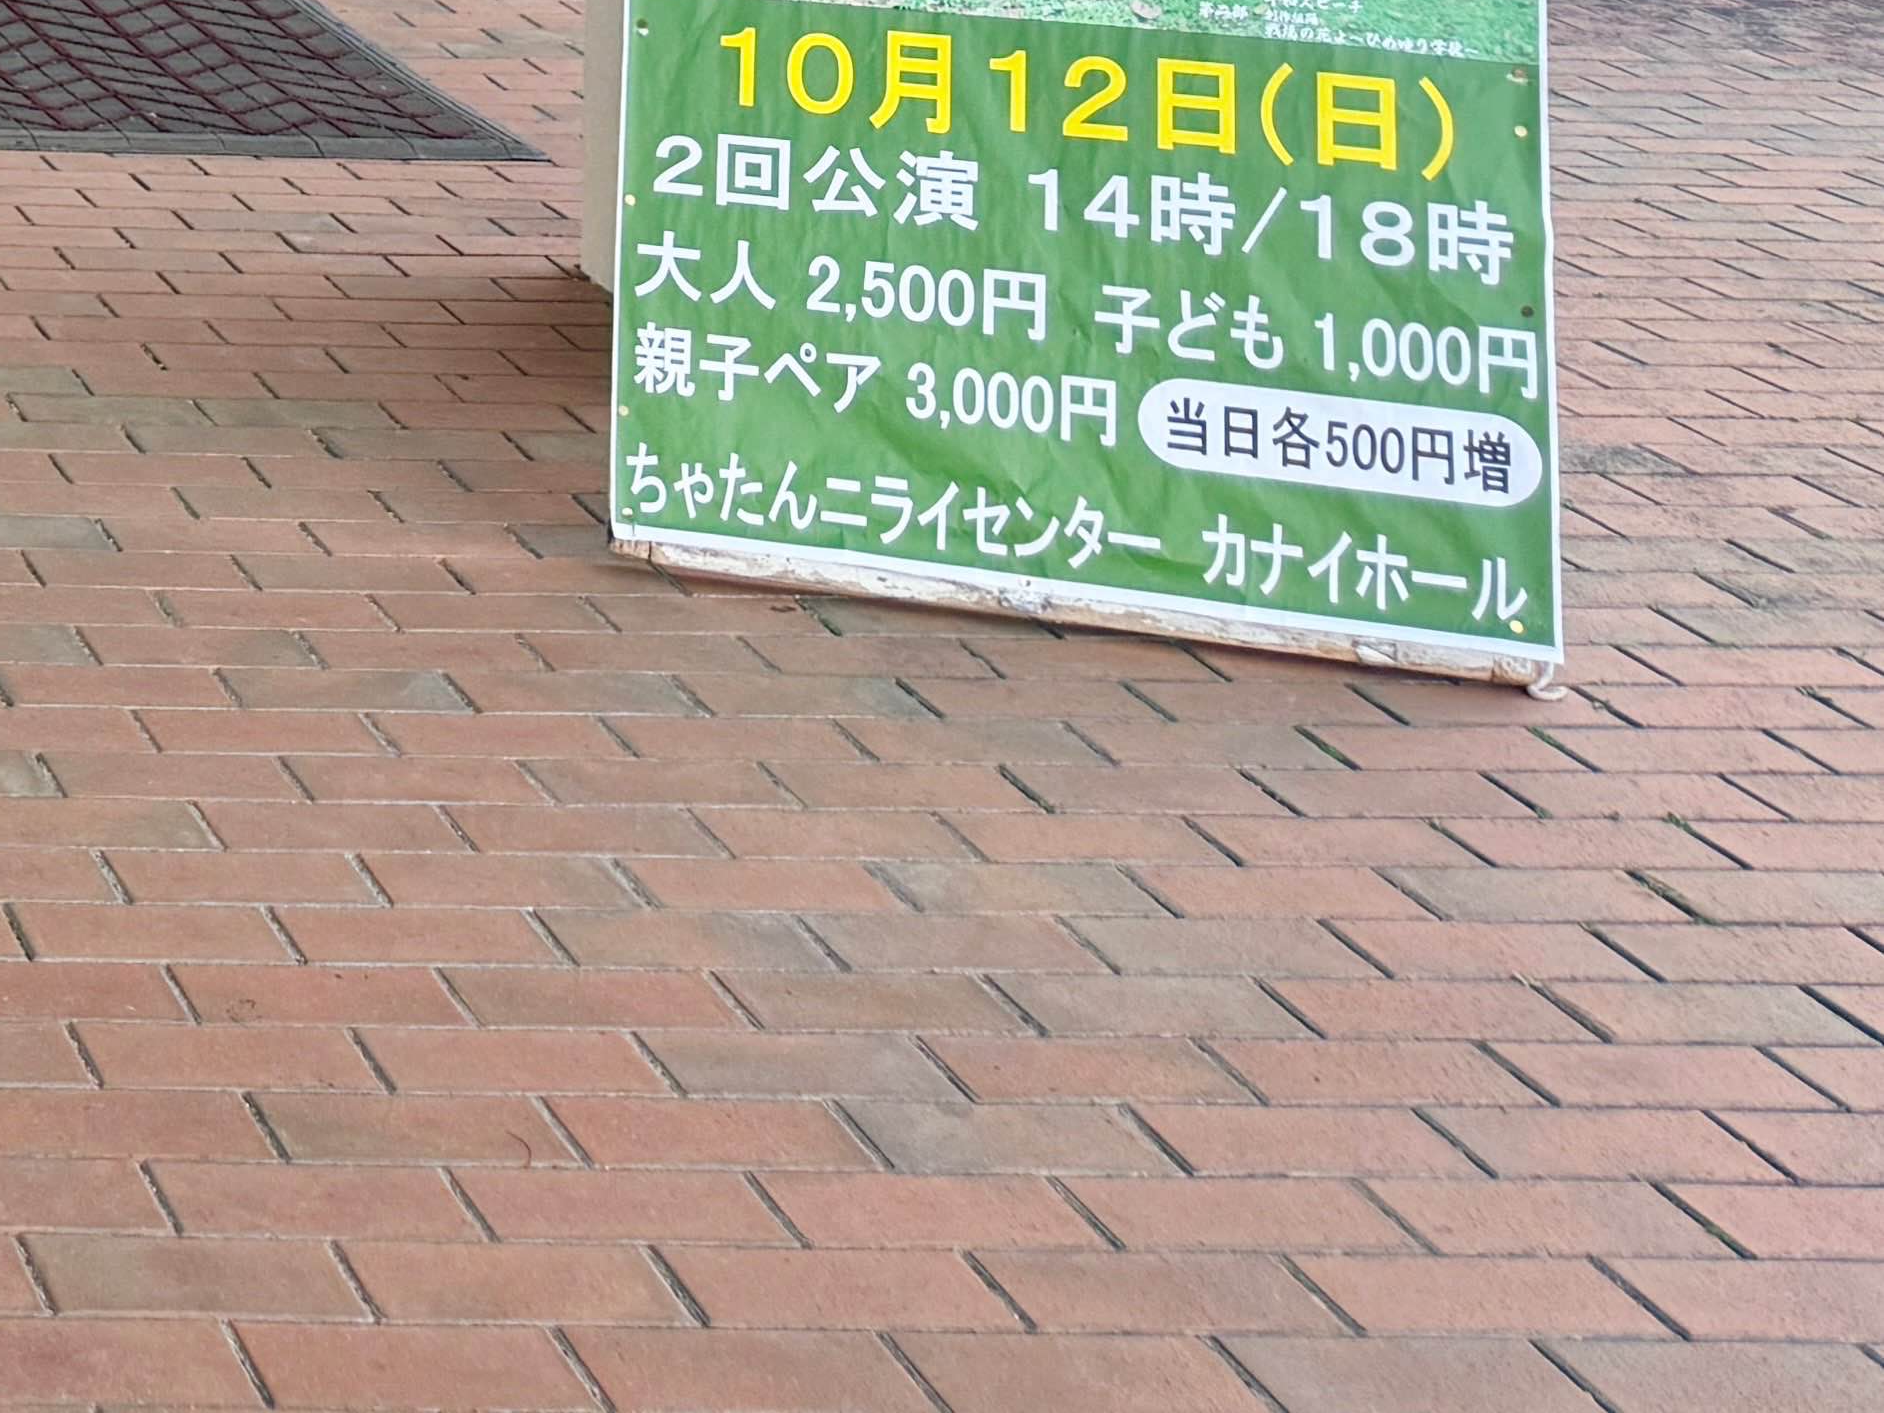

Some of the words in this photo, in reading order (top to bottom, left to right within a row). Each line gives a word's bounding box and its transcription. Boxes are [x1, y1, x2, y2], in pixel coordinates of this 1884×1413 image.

[719, 26, 1453, 180] 10月12日(日)
[654, 133, 980, 230] 2回公演
[1031, 172, 1514, 285] 14時/18時
[634, 234, 775, 311] 大人
[807, 254, 1047, 340] 2,500円
[1095, 286, 1284, 368] 子ども
[1315, 315, 1537, 399] 1,000円
[633, 324, 879, 415] 親子ペア
[905, 361, 1117, 446] 3,000円
[1166, 401, 1512, 493] 当日各500円増
[627, 444, 1160, 571] ちゃたんニライセンター
[1205, 515, 1527, 622] カナイホール
